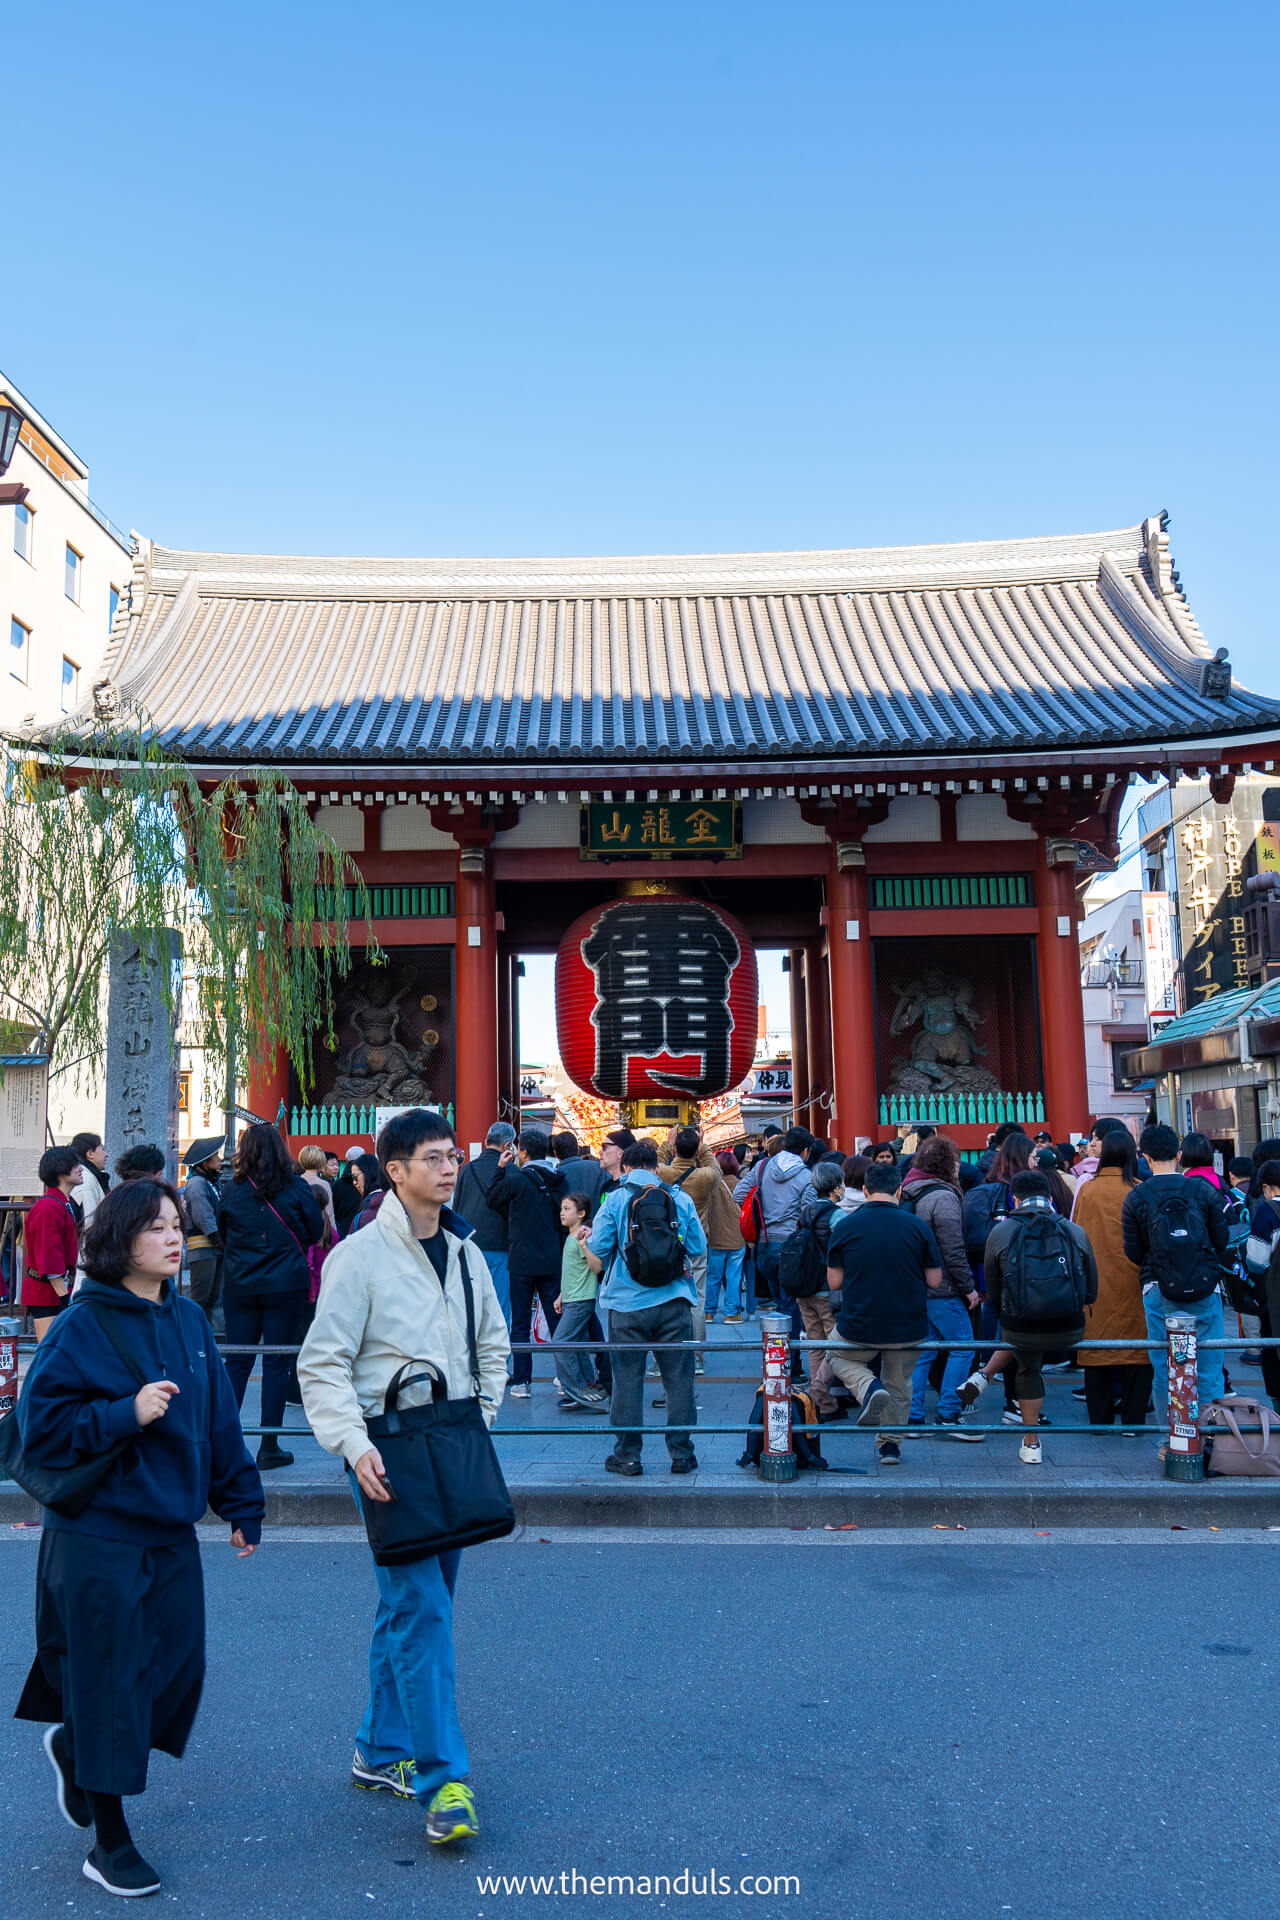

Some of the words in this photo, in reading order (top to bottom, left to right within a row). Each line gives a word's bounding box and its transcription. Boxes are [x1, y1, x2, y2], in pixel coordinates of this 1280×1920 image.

[1223, 815, 1243, 898] KOBE
[1261, 826, 1276, 872] 鉄板
[580, 901, 741, 1097] 雷門
[1161, 957, 1173, 1009] BEEF
[758, 1070, 792, 1090] 仲見
